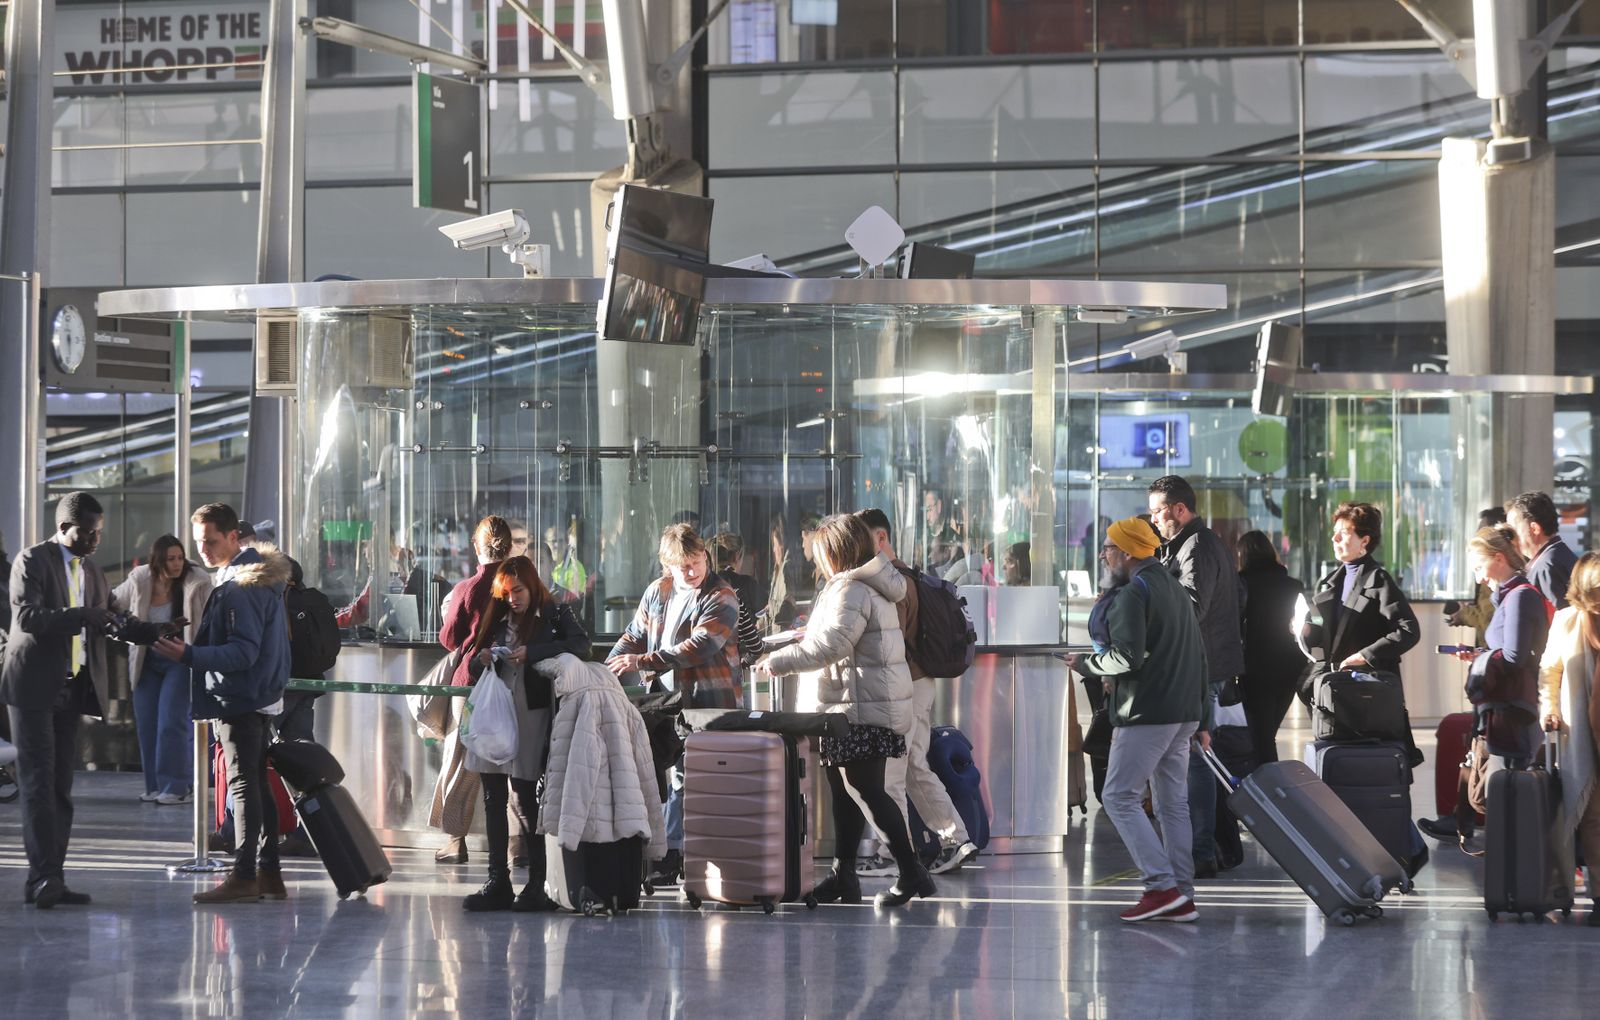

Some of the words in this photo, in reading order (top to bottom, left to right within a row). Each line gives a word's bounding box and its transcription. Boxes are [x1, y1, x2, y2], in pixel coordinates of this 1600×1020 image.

[100, 16, 172, 43] HOME
[180, 14, 209, 41] OF
[216, 12, 261, 39] THE
[463, 150, 478, 209] 1
